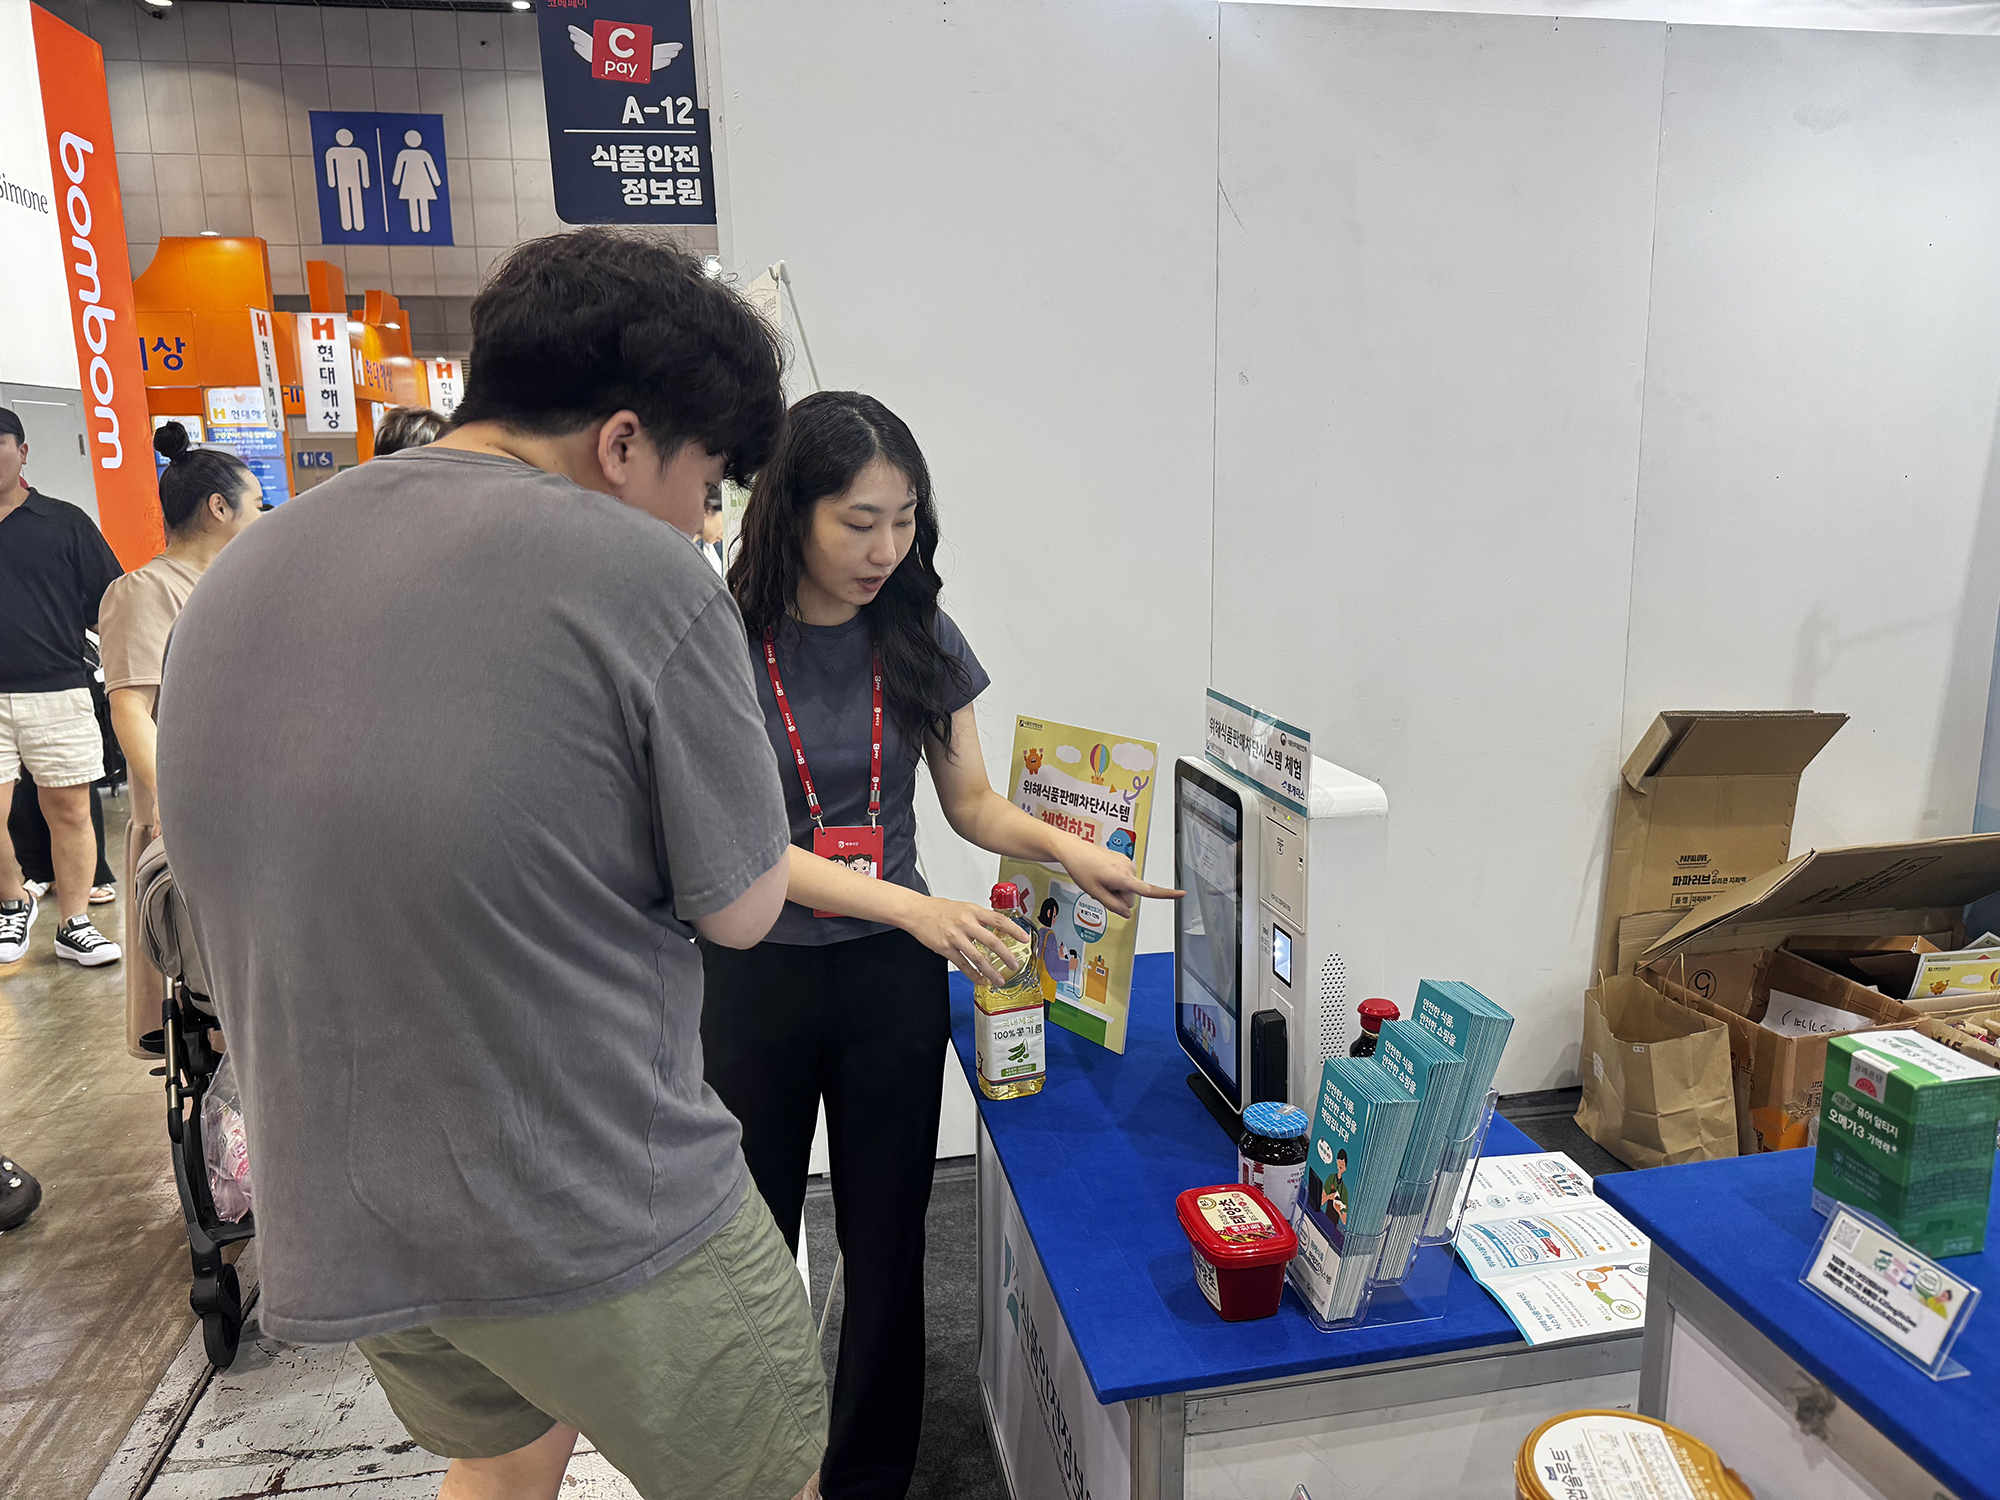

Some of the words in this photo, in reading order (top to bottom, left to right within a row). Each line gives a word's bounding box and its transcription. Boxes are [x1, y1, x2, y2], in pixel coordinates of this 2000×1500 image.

[609, 27, 636, 59] C
[604, 60, 639, 78] pay
[621, 95, 695, 125] A-12
[591, 144, 701, 173] 식품안전
[621, 178, 703, 206] 정보원
[59, 131, 126, 470] bombom
[317, 344, 341, 429] 현대해상
[365, 359, 394, 393] 현대해상
[1209, 717, 1283, 771] 위해식품판매차단시스템
[1284, 754, 1302, 781] 체험
[1023, 779, 1131, 823] 위해식품판매차단시스템
[1680, 854, 1708, 862] PAPALOVE
[1672, 874, 1711, 886] 파파러브
[1003, 1016, 1035, 1027] 국내제조
[1423, 999, 1441, 1019] 안전한
[1440, 1011, 1454, 1028] 식품,
[1420, 1013, 1438, 1034] 안전한
[1437, 1026, 1457, 1048] 쇼핑을
[1385, 1040, 1402, 1063] 안전한
[1402, 1056, 1415, 1075] 식품,
[1854, 1062, 1883, 1083] 고려은단
[1382, 1054, 1400, 1078] 안전한
[1399, 1071, 1417, 1095] 쇼핑을
[1326, 1079, 1343, 1103] 안전한
[1342, 1095, 1355, 1115] 식품,
[1323, 1093, 1341, 1117] 안전한
[1339, 1111, 1358, 1135] 쇼핑을
[1828, 1108, 1865, 1139] 오메가3
[1856, 1106, 1874, 1125] 퓨어
[1873, 1115, 1899, 1139] 알티지
[1218, 1198, 1246, 1225] 태양초
[1021, 1291, 1093, 1500] 식품안전정보
[1550, 1449, 1589, 1500] 앱솔루트
